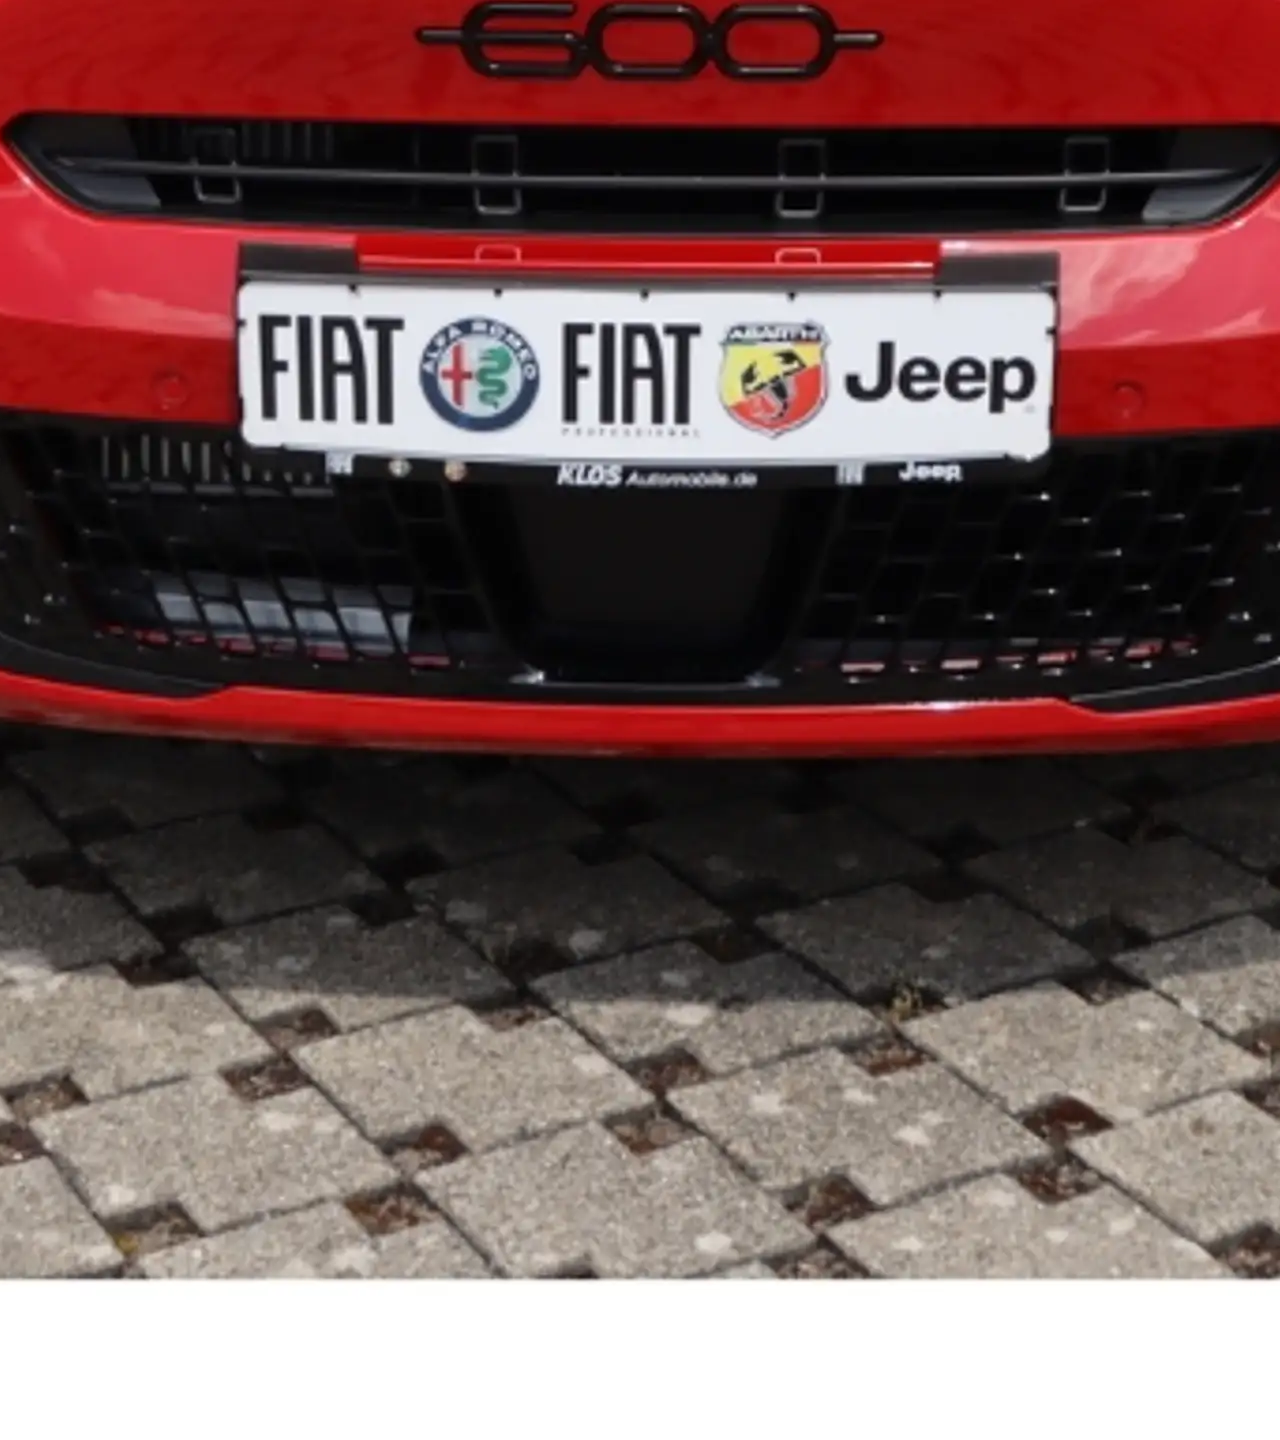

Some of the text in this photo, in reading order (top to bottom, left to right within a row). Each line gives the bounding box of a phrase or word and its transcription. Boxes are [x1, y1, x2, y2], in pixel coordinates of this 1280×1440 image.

[258, 314, 405, 425] FIAT
[562, 322, 701, 425] FIAT
[845, 341, 1036, 413] Jeep
[557, 463, 622, 486] KLOS
[898, 461, 963, 483] Jeep
